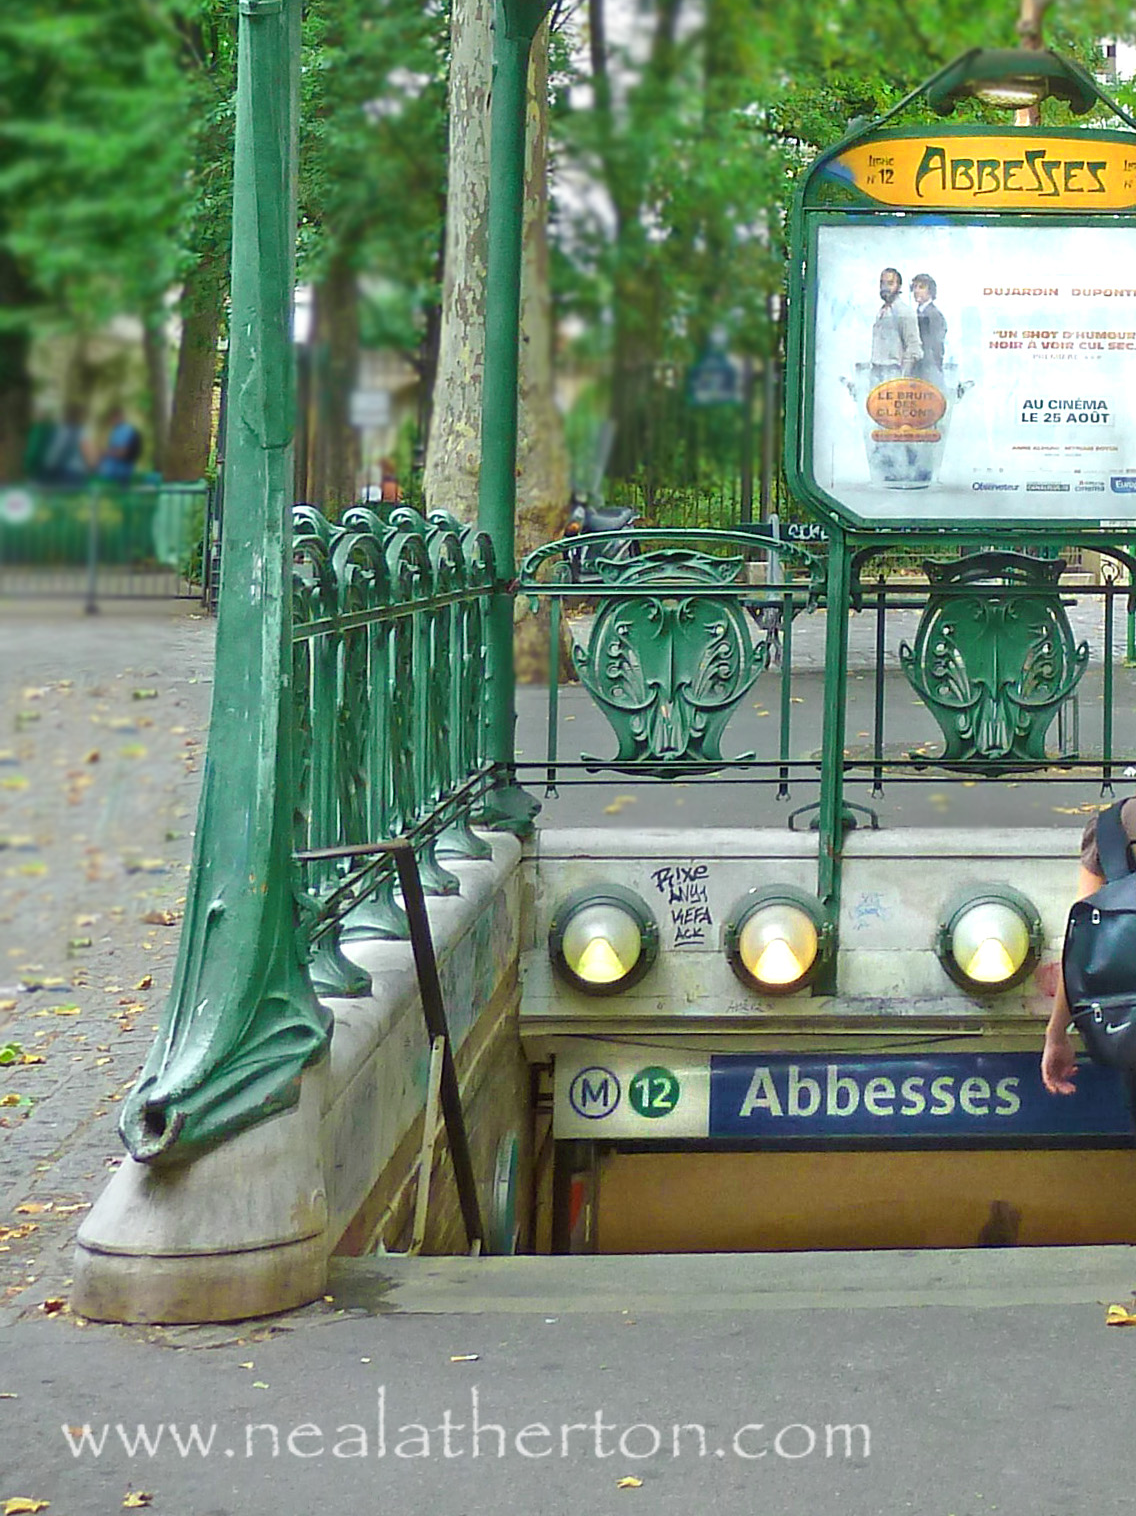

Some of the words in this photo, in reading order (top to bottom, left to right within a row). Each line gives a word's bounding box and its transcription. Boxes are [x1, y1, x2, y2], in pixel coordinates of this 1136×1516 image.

[879, 169, 894, 184] 12
[915, 145, 1107, 197] ABBESSES
[983, 288, 1059, 296] DUJARDIN
[1022, 331, 1059, 339] SHOT
[1062, 331, 1136, 340] D'HUMOUR
[989, 341, 1023, 349] NOIR
[1041, 341, 1074, 349] VOIR
[1079, 342, 1104, 350] CUL
[878, 392, 893, 400] LE
[897, 392, 934, 400] BRUIT
[1022, 399, 1044, 409] AU
[1048, 397, 1108, 410] CINÉMA
[1021, 412, 1038, 422] LE
[1043, 413, 1061, 423] 25
[1066, 411, 1111, 423] AOÛT
[636, 1078, 671, 1108] 12
[738, 1065, 1021, 1118] Abbesses
